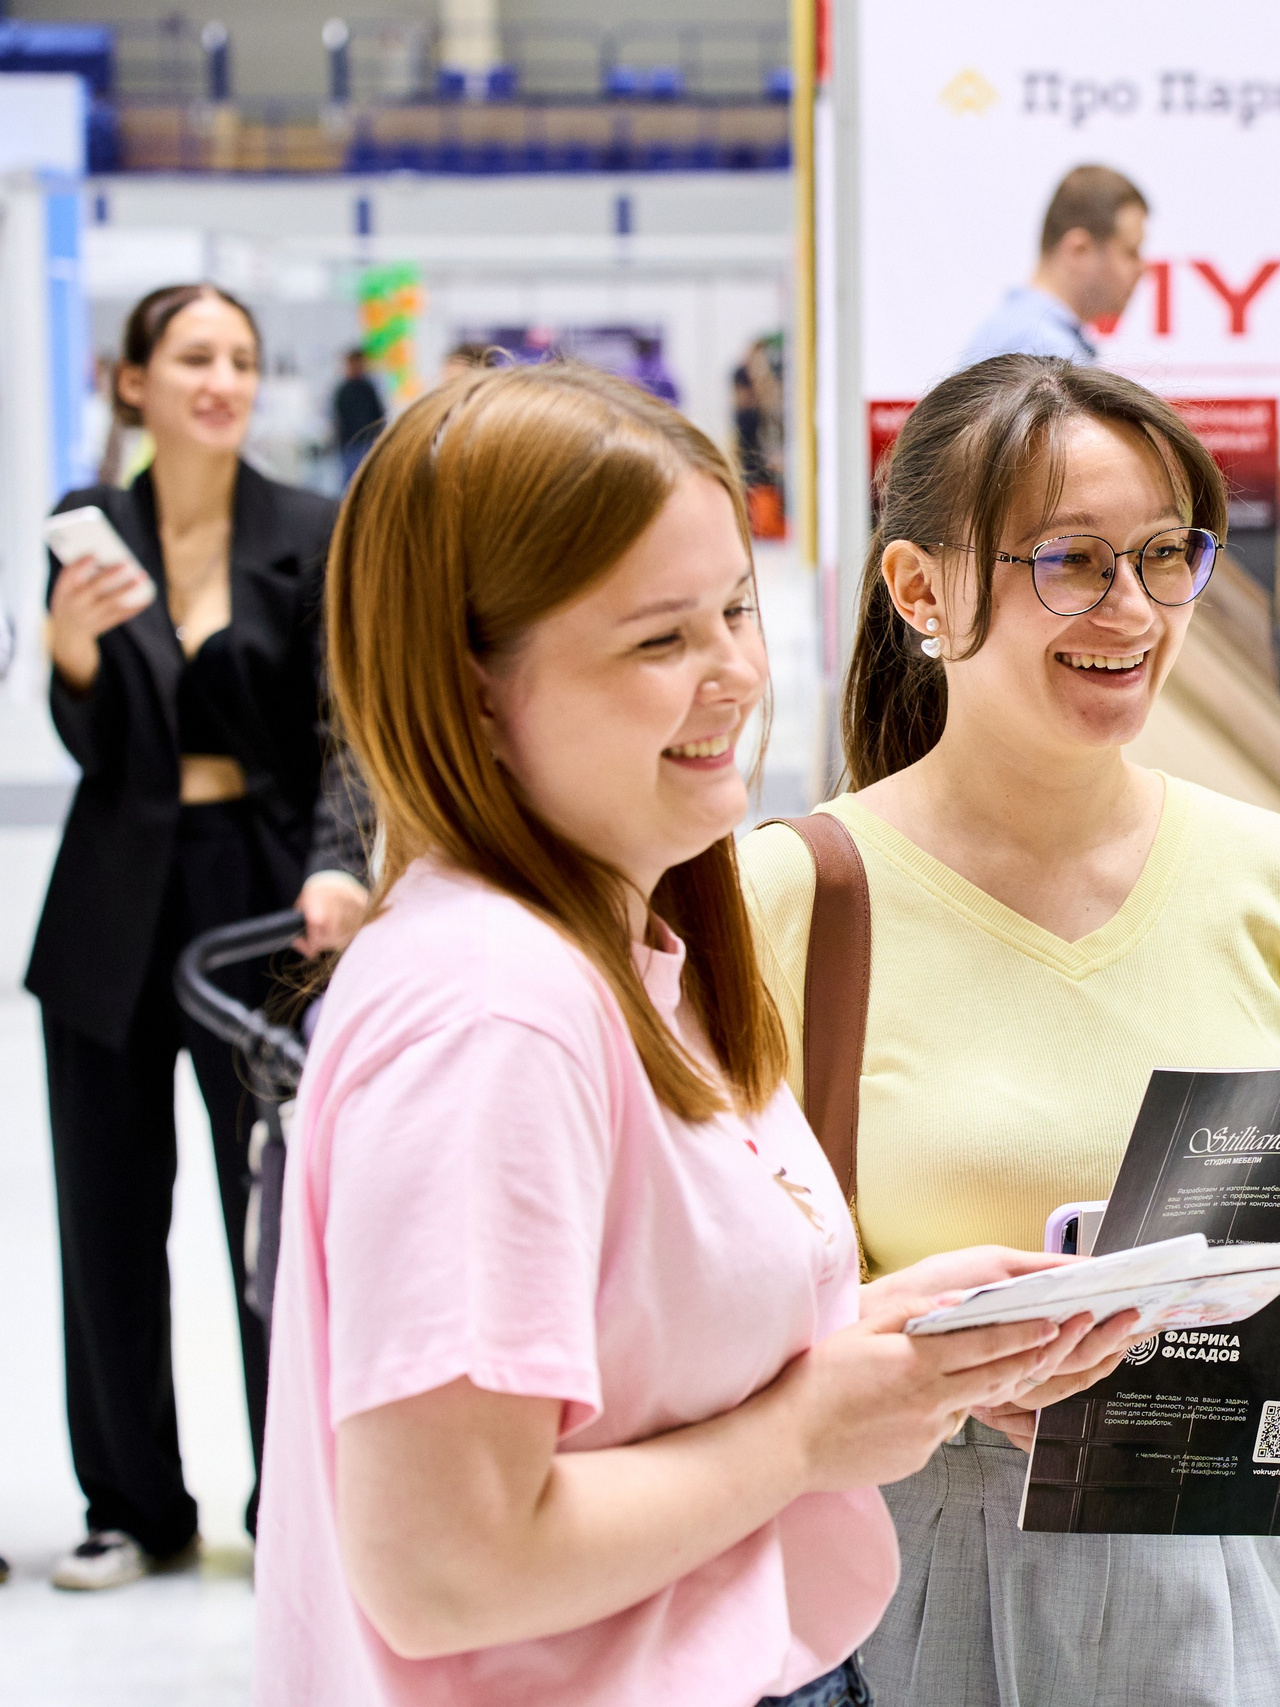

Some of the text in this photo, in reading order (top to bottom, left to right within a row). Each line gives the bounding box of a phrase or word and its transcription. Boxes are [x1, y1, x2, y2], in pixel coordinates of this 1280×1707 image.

[1023, 72, 1137, 128] Про
[1204, 1156, 1263, 1166] СТУДИЯ МЕБЕЛИ
[1177, 1186, 1218, 1194] Разработаем
[1164, 1330, 1241, 1348] ФАБРИКА
[1161, 1345, 1241, 1363] ФАСАДОВ
[1116, 1391, 1152, 1400] Подберем
[1155, 1393, 1182, 1402] фасады
[1185, 1395, 1199, 1403] под
[1106, 1400, 1148, 1408] рассчитаем
[1149, 1402, 1186, 1410] стоимость
[1195, 1404, 1236, 1413] предложим
[1104, 1417, 1129, 1425] сроков
[1135, 1418, 1173, 1426] доработок.
[1182, 1412, 1208, 1421] работы
[1208, 1412, 1221, 1421] без
[1221, 1414, 1247, 1422] срывов
